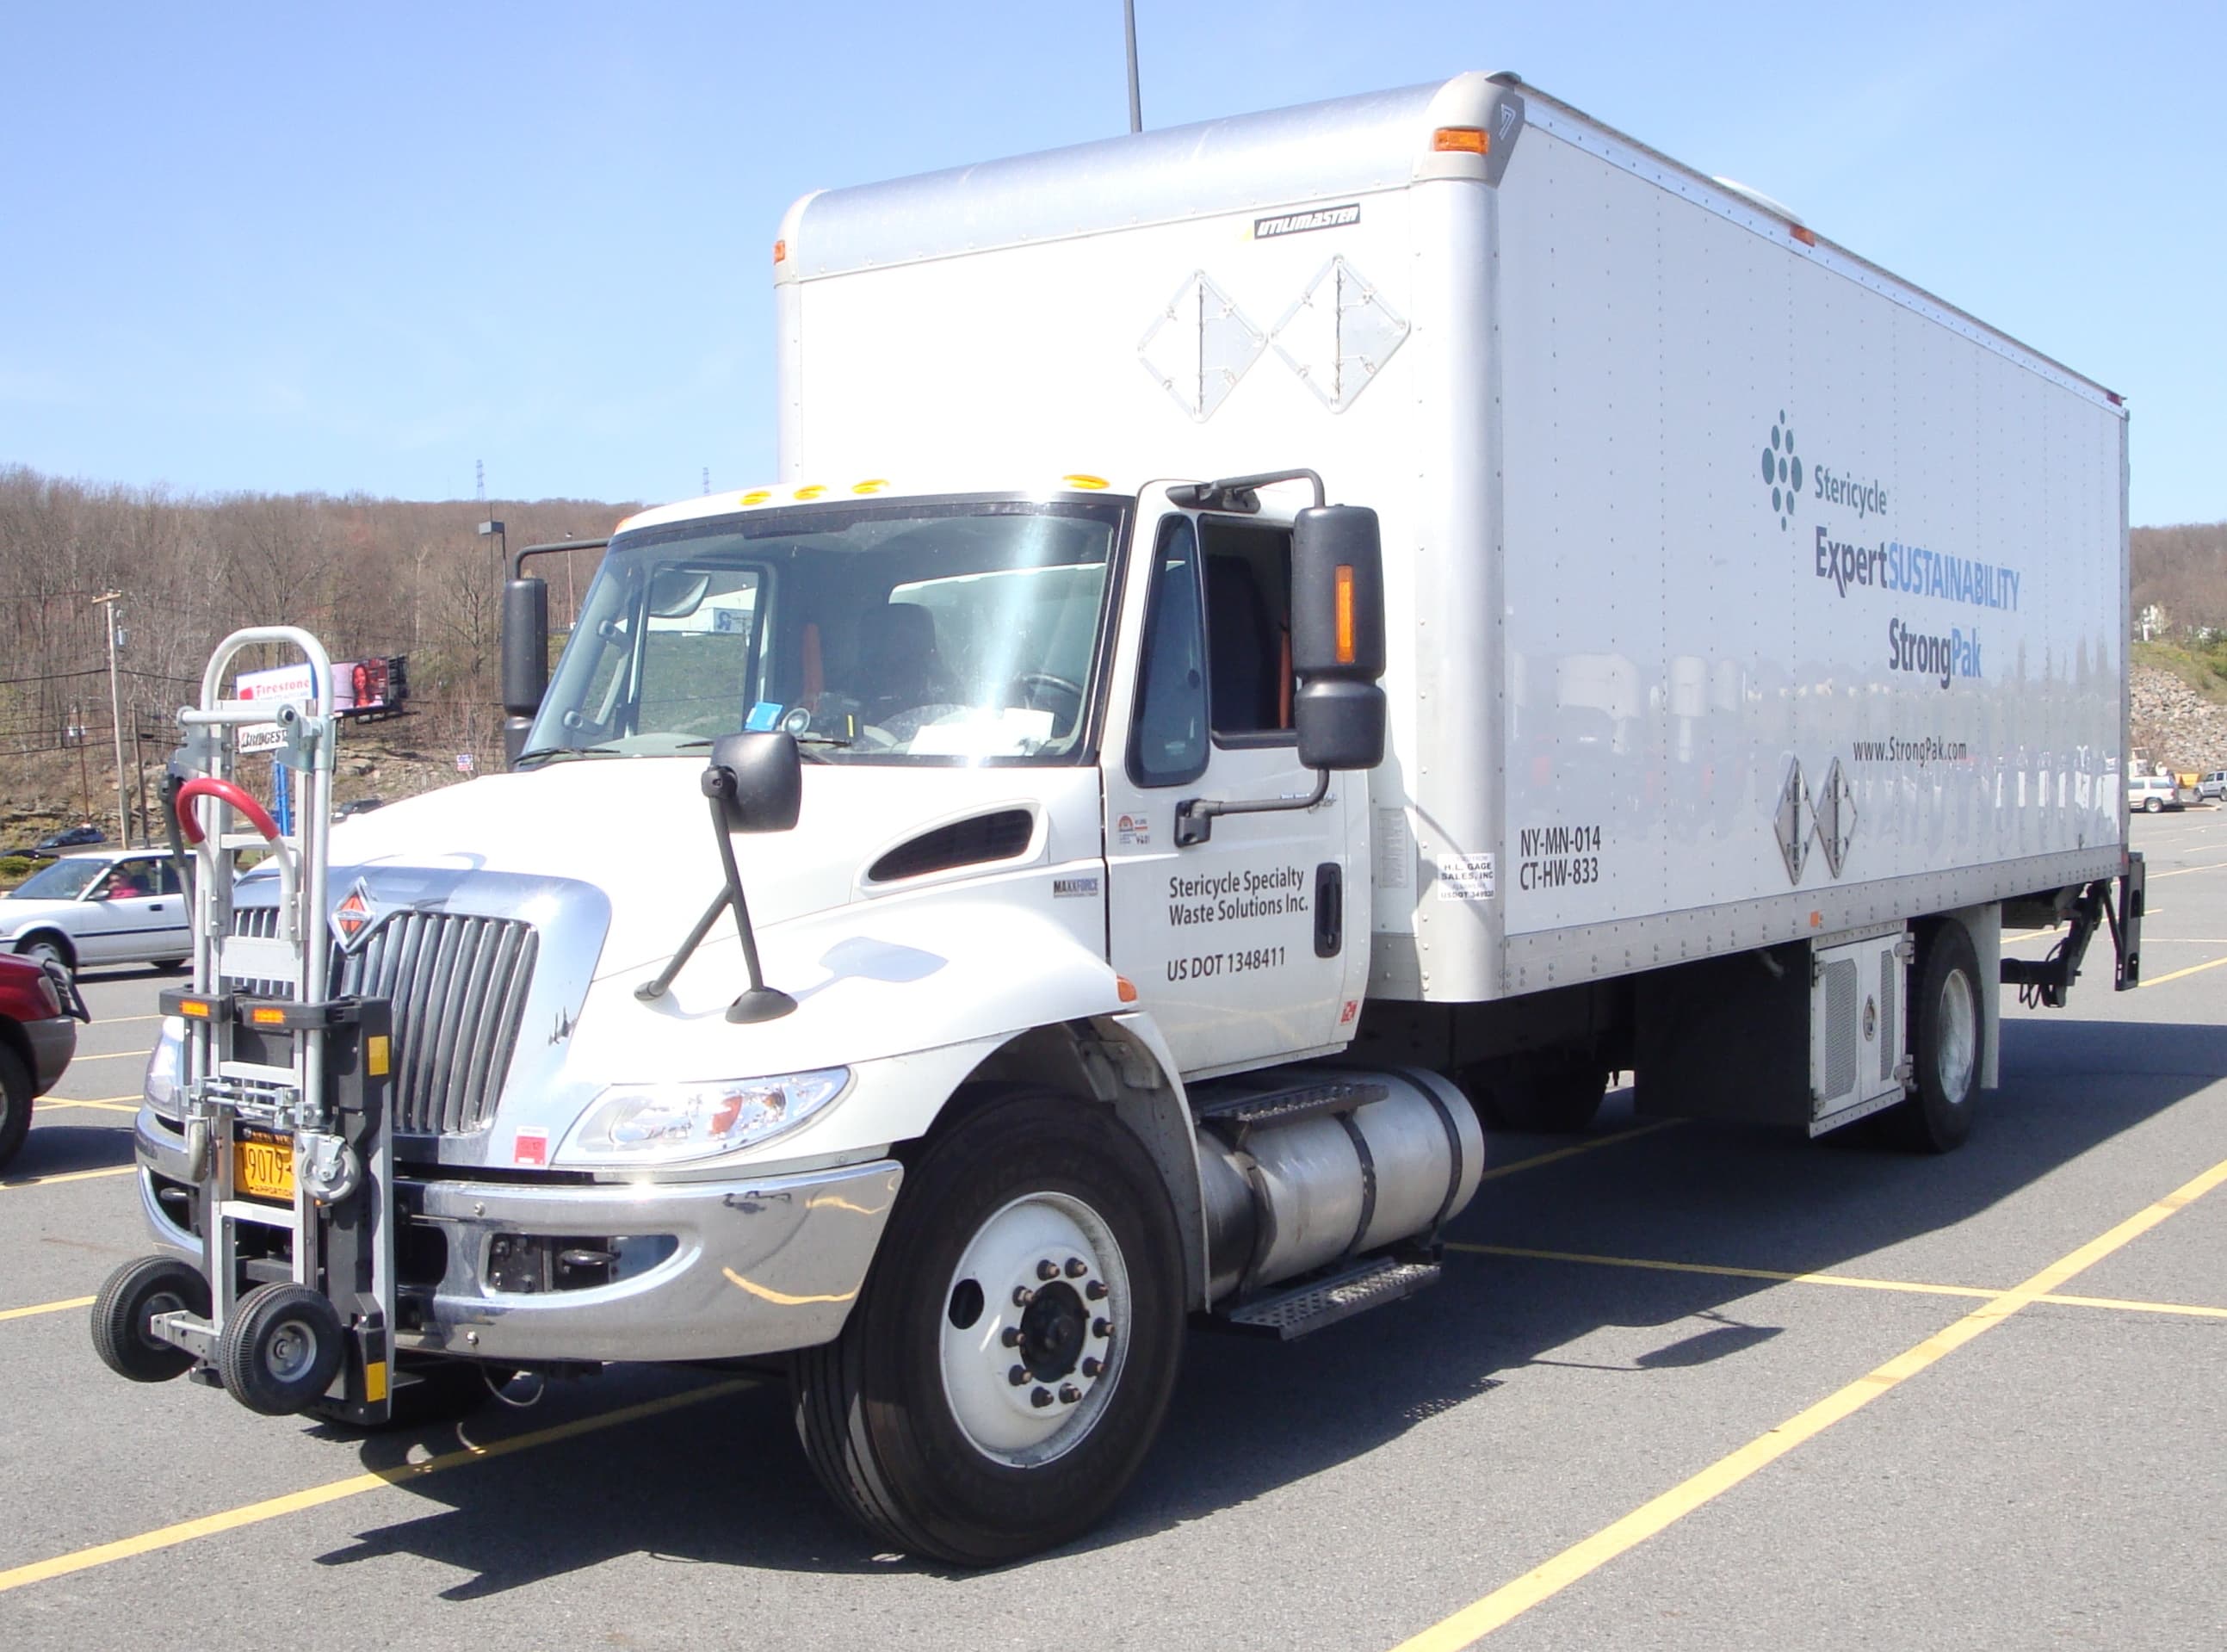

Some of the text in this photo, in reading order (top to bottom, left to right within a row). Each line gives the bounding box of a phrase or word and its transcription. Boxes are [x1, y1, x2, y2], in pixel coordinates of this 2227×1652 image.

[1257, 206, 1358, 237] UTILIMASTER
[1815, 464, 1887, 518] Stericycle
[1816, 525, 2020, 611] ExpertSUSTAINABILITY
[1889, 617, 1982, 690] StrongPak
[256, 678, 310, 696] Firestone
[240, 730, 288, 748] BRIDGEST
[1853, 736, 1967, 768] www.StrongPak.com
[1520, 826, 1601, 857] NY-MN-014
[1169, 866, 1304, 900] Stericycle Specialty
[1519, 857, 1599, 890] CT-HW-833
[1169, 893, 1308, 926] Waste Solutions Inc.
[1167, 946, 1285, 981] US DOT 1348411
